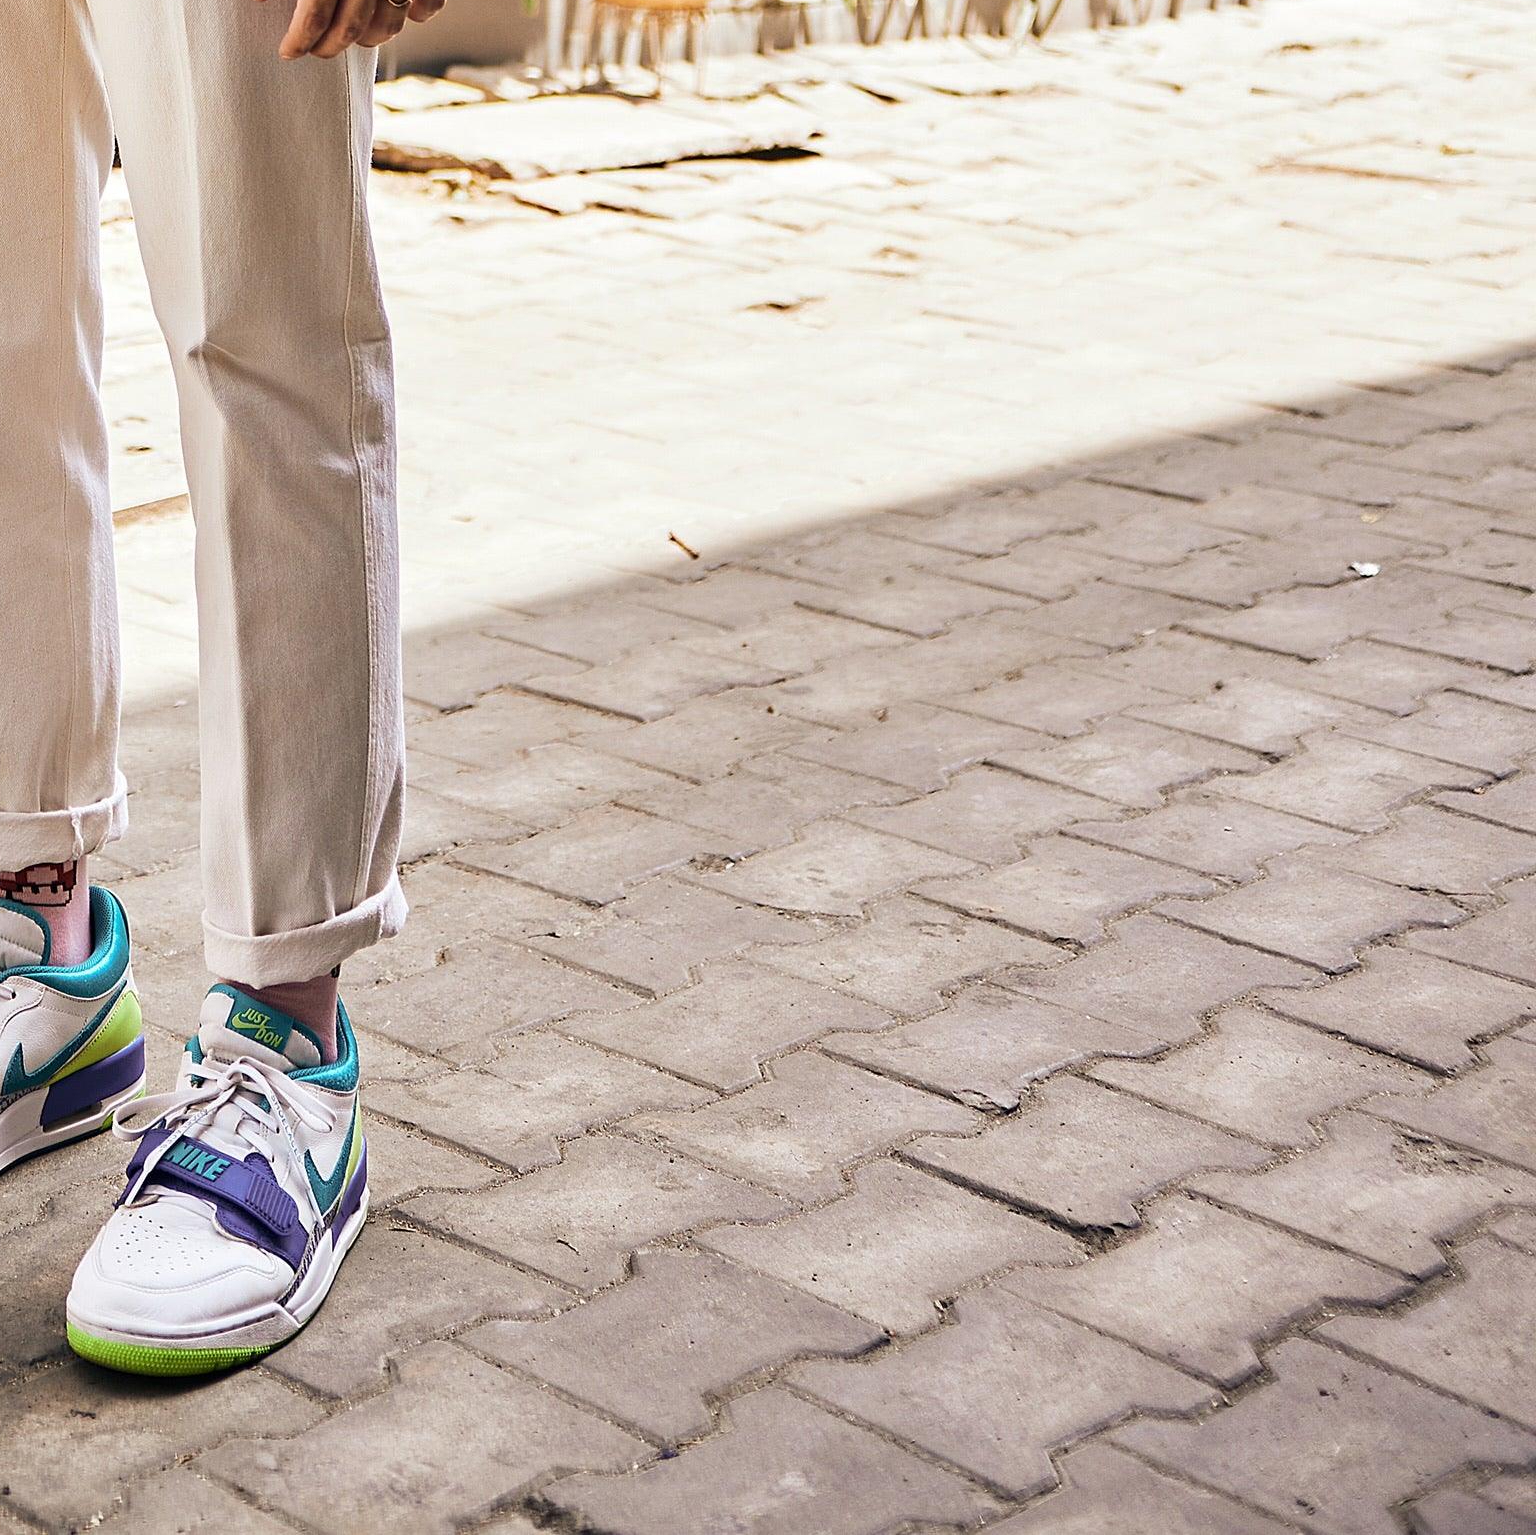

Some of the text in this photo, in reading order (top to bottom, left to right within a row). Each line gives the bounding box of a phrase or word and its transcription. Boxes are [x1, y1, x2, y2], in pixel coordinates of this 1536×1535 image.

[241, 1007, 272, 1028] JUST
[254, 1028, 284, 1048] DON
[164, 1141, 232, 1182] NIKE
